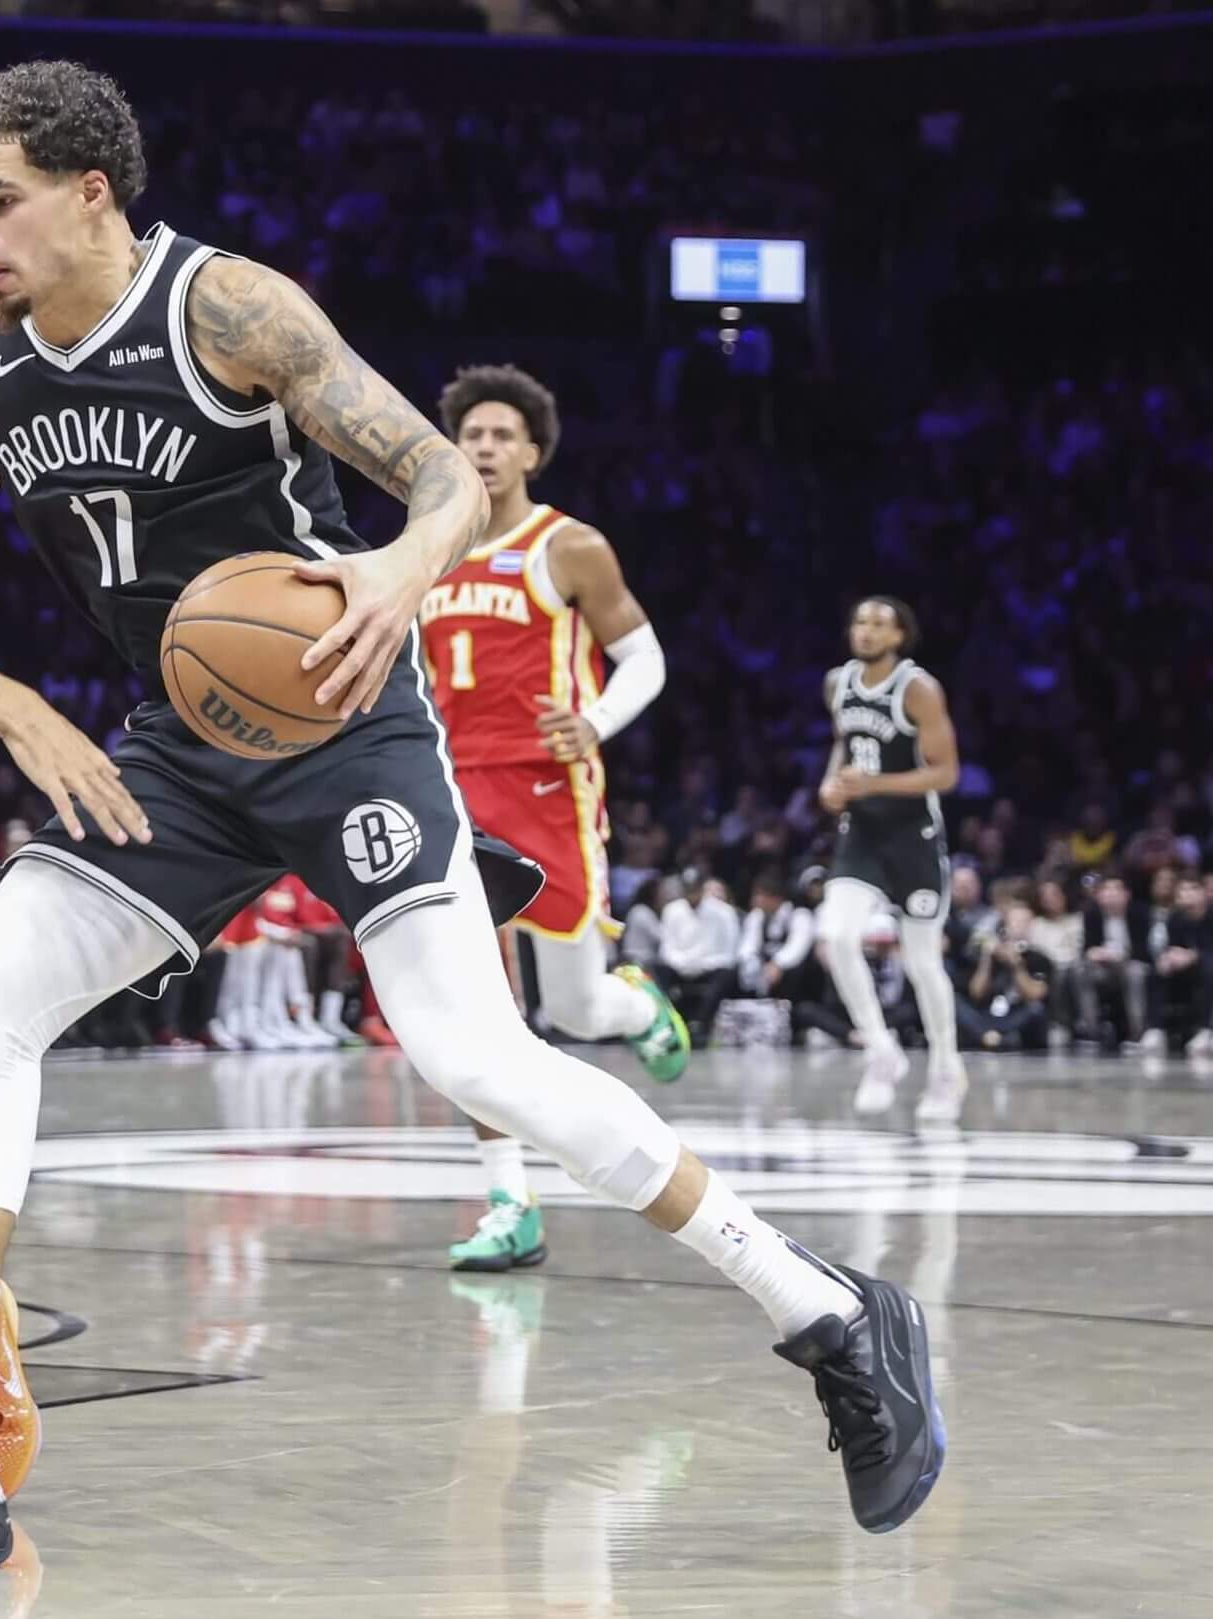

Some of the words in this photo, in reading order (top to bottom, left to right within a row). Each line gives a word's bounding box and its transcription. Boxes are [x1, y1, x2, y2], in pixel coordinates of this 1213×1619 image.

[109, 348, 125, 367] All
[126, 347, 139, 364] In
[138, 344, 165, 361] Won
[69, 489, 138, 587] 17
[450, 629, 476, 690] 1
[199, 687, 318, 753] Wilson
